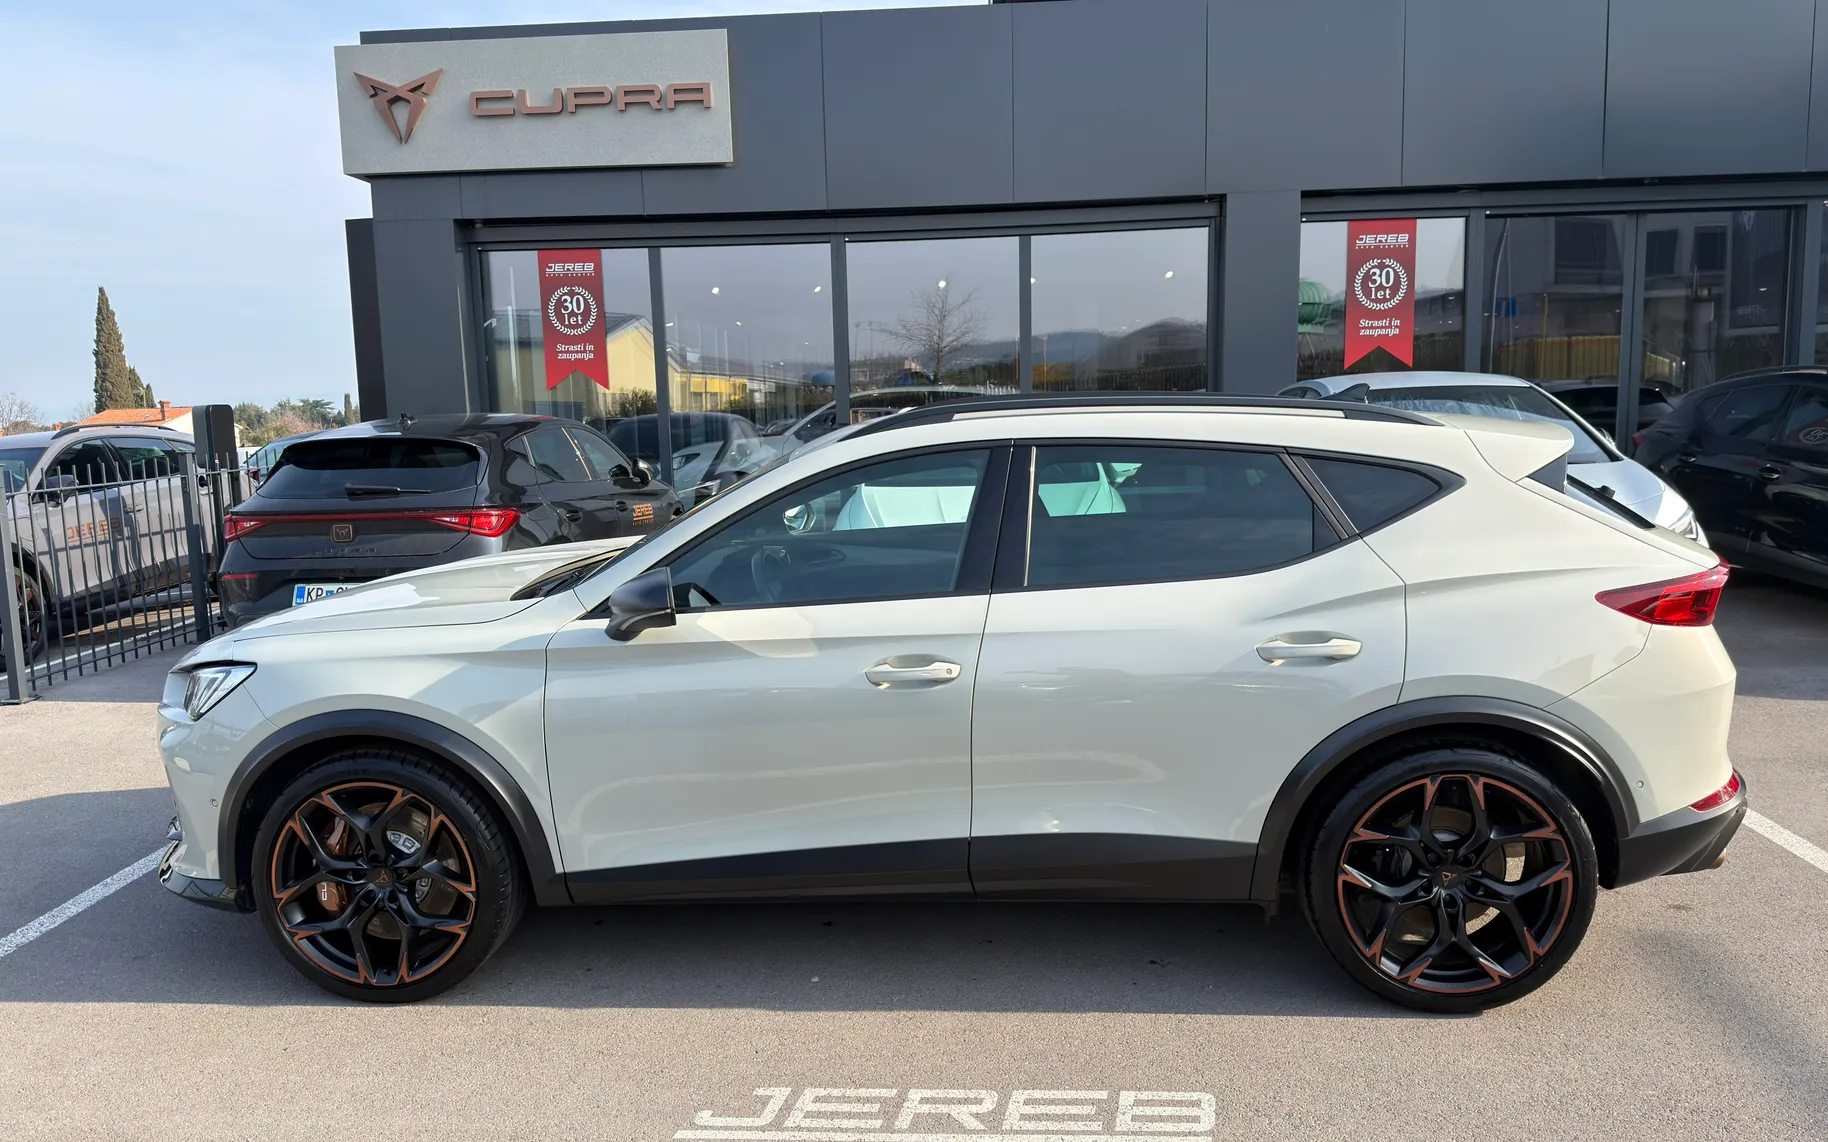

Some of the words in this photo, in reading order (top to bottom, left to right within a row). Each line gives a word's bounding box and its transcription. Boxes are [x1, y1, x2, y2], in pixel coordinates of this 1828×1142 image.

[469, 82, 713, 117] CUPRA
[1356, 234, 1409, 243] JEREB
[546, 263, 594, 271] JEREB
[1368, 267, 1394, 287] 30
[1371, 288, 1391, 299] let
[561, 295, 584, 313] 30
[564, 314, 583, 325] let
[1359, 318, 1390, 327] Strasti
[1391, 317, 1400, 326] in
[1359, 327, 1399, 337] zaupanja
[556, 343, 584, 352] Strasti
[585, 343, 594, 351] in
[557, 351, 594, 361] zaupanja
[694, 1087, 1217, 1132] JEREB
